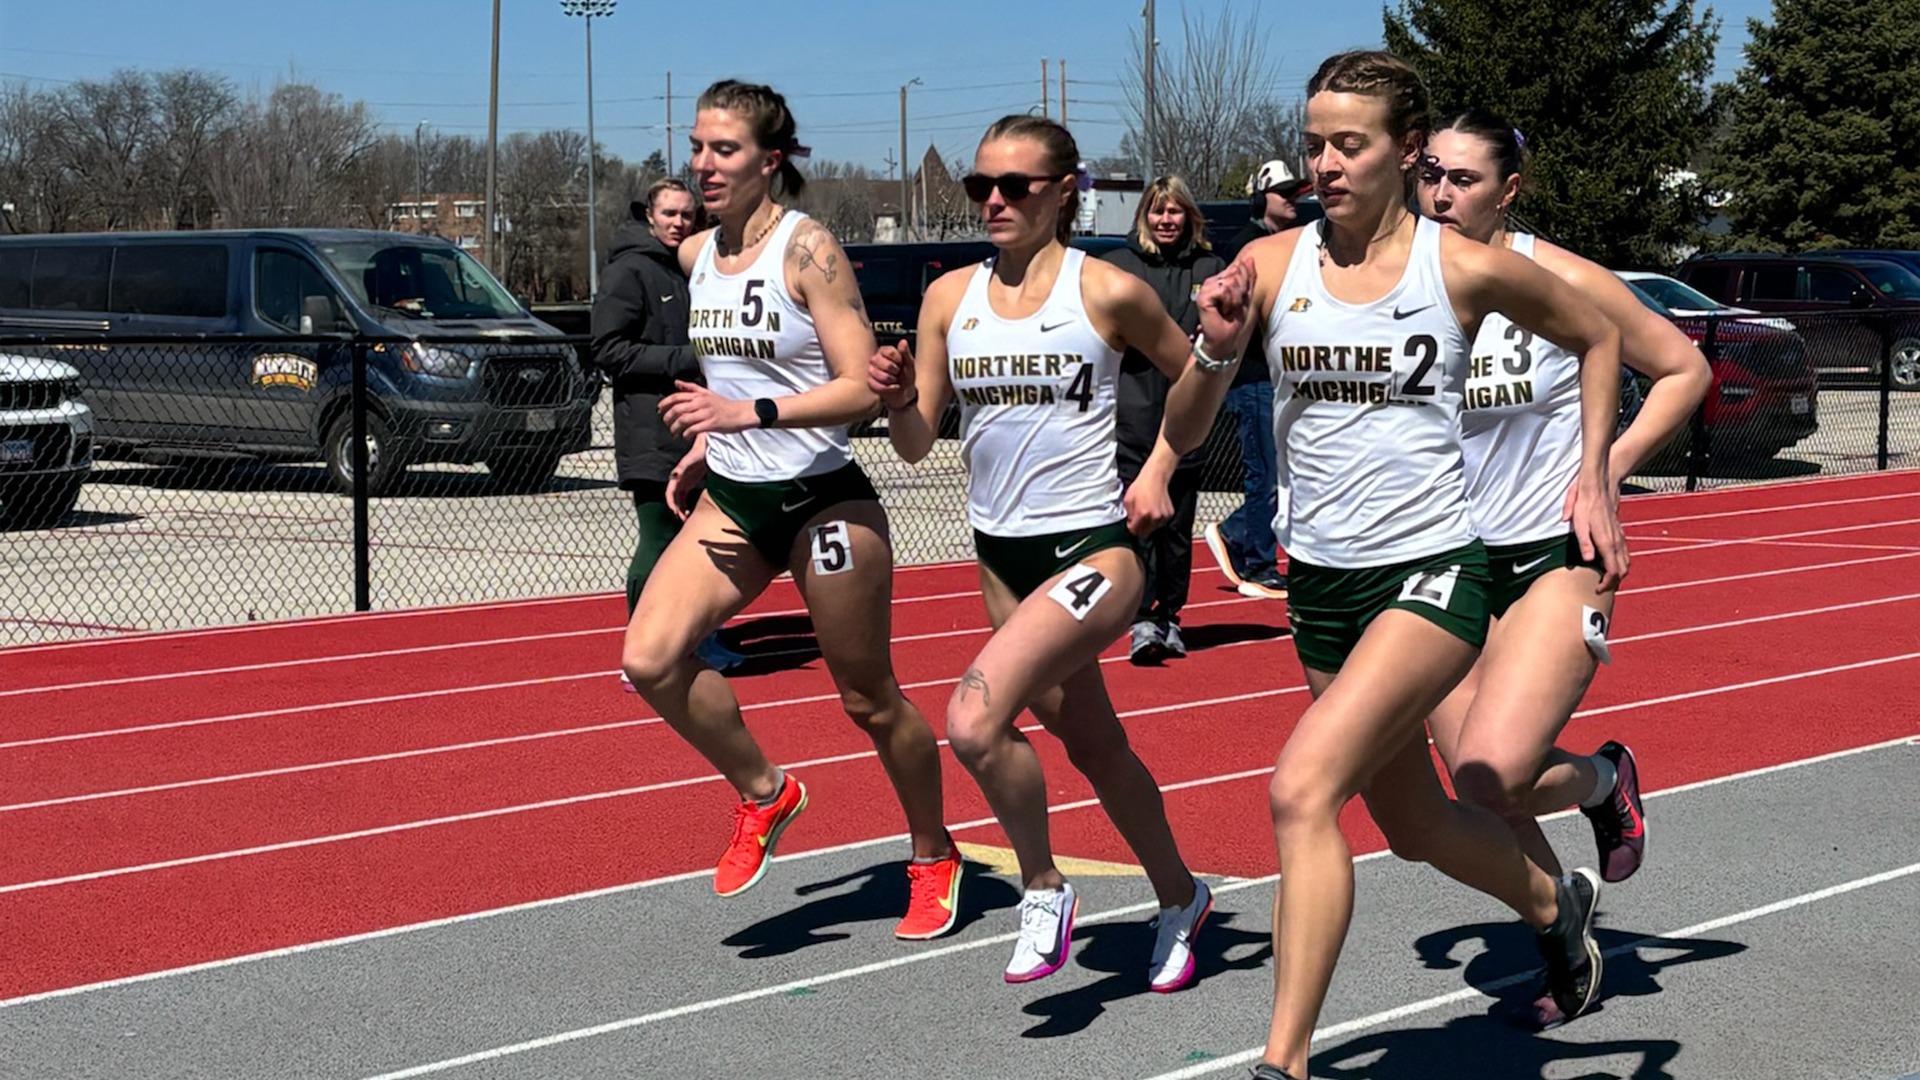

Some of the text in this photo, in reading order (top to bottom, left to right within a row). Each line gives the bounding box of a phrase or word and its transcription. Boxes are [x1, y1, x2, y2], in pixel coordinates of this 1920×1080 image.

[690, 310, 781, 332] ORTHN
[741, 280, 764, 328] 5
[1281, 346, 1392, 372] NORTHE
[1402, 334, 1438, 396] 2
[1502, 323, 1533, 375] 3
[961, 384, 1058, 407] MICHIGA
[1065, 362, 1094, 412] 4
[1292, 381, 1394, 404] MICHIG
[817, 524, 846, 572] 5
[1065, 571, 1105, 611] 4
